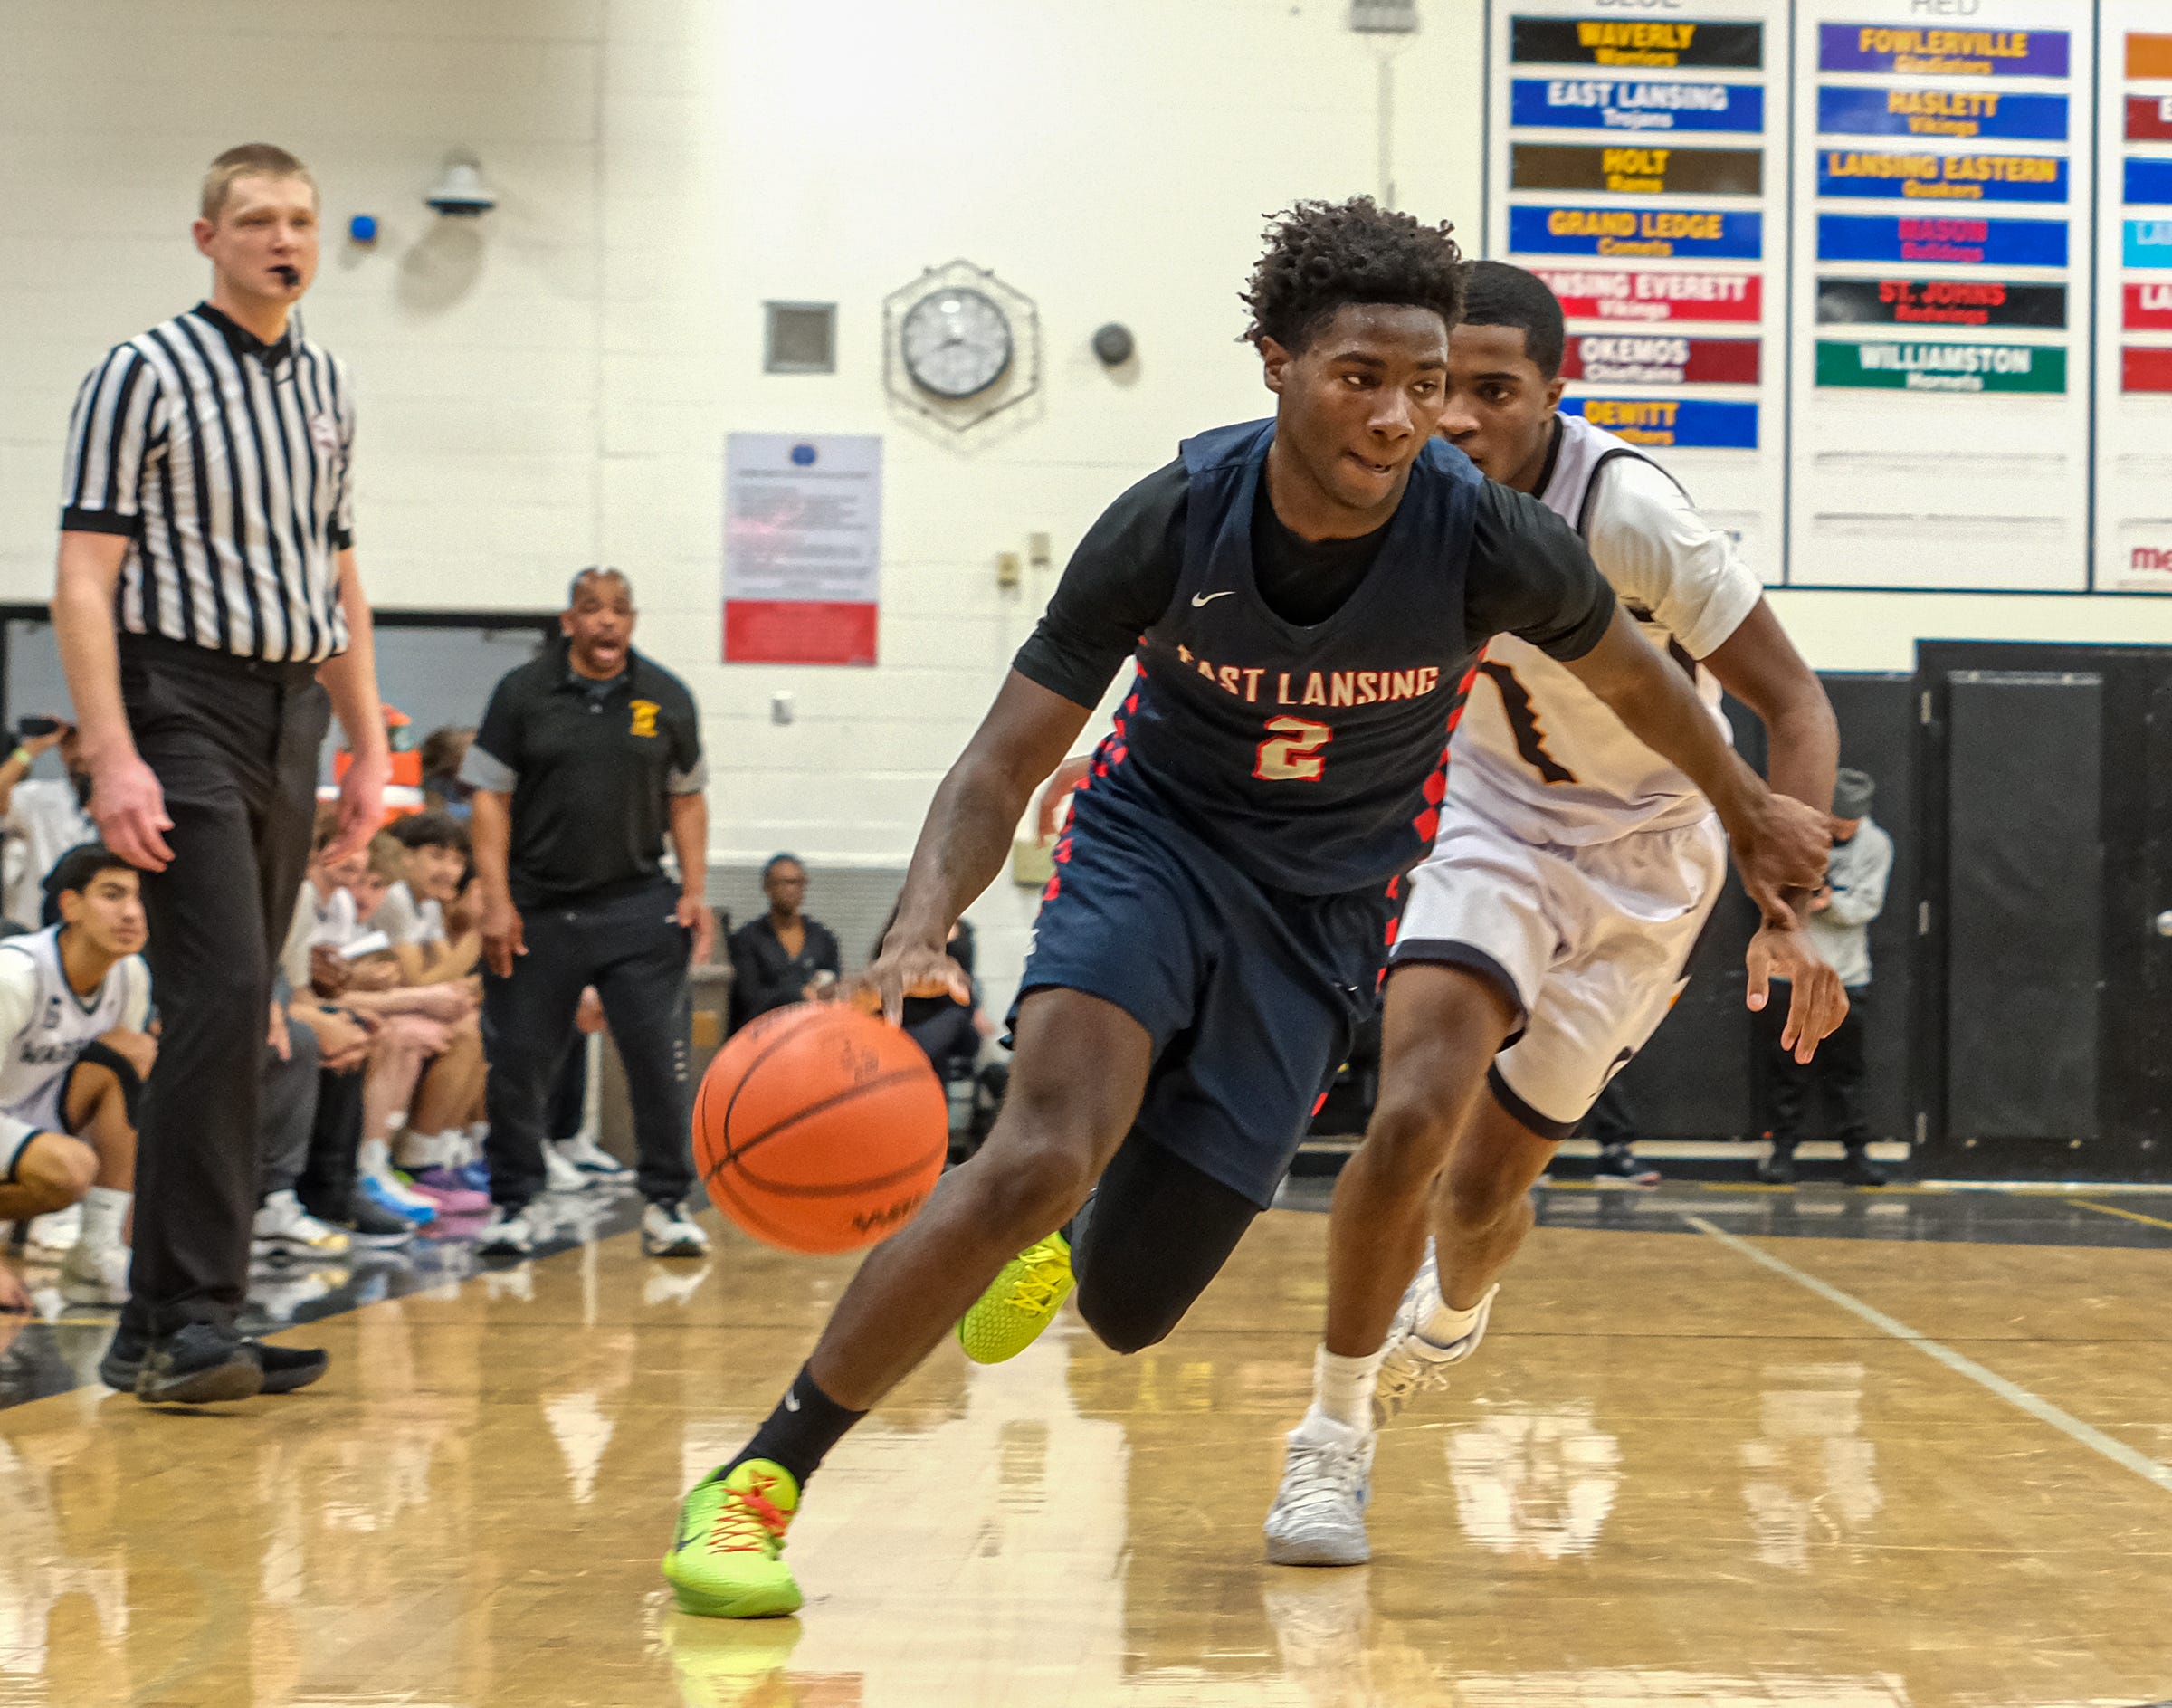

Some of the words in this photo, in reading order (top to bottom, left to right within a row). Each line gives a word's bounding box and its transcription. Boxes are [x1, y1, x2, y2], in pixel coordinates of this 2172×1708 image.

[1577, 22, 1696, 49] WAVERLY
[1859, 28, 2028, 57] FOWLERVILLE
[1547, 81, 1613, 106] EAST
[1617, 83, 1729, 111] LANSING
[1887, 91, 1999, 117] HASLETT
[1603, 148, 1670, 174] HOLT
[1828, 153, 1939, 178] LANSING
[1943, 157, 2057, 182] EASTERN
[1548, 210, 1636, 237] GRAND
[1641, 213, 1723, 239] LEDGE
[1899, 217, 1988, 242] MASON
[1538, 272, 1628, 299] NSING
[1634, 275, 1748, 301] EVERETT
[1879, 280, 1916, 303] ST.
[1921, 281, 2006, 306] JOHNS
[1579, 337, 1690, 365] OKEMOS
[1858, 346, 2032, 374] WILLIAMSTON
[1583, 400, 1681, 426] DEWITT
[1277, 666, 1440, 708] LANSING
[1252, 714, 1332, 782] 2
